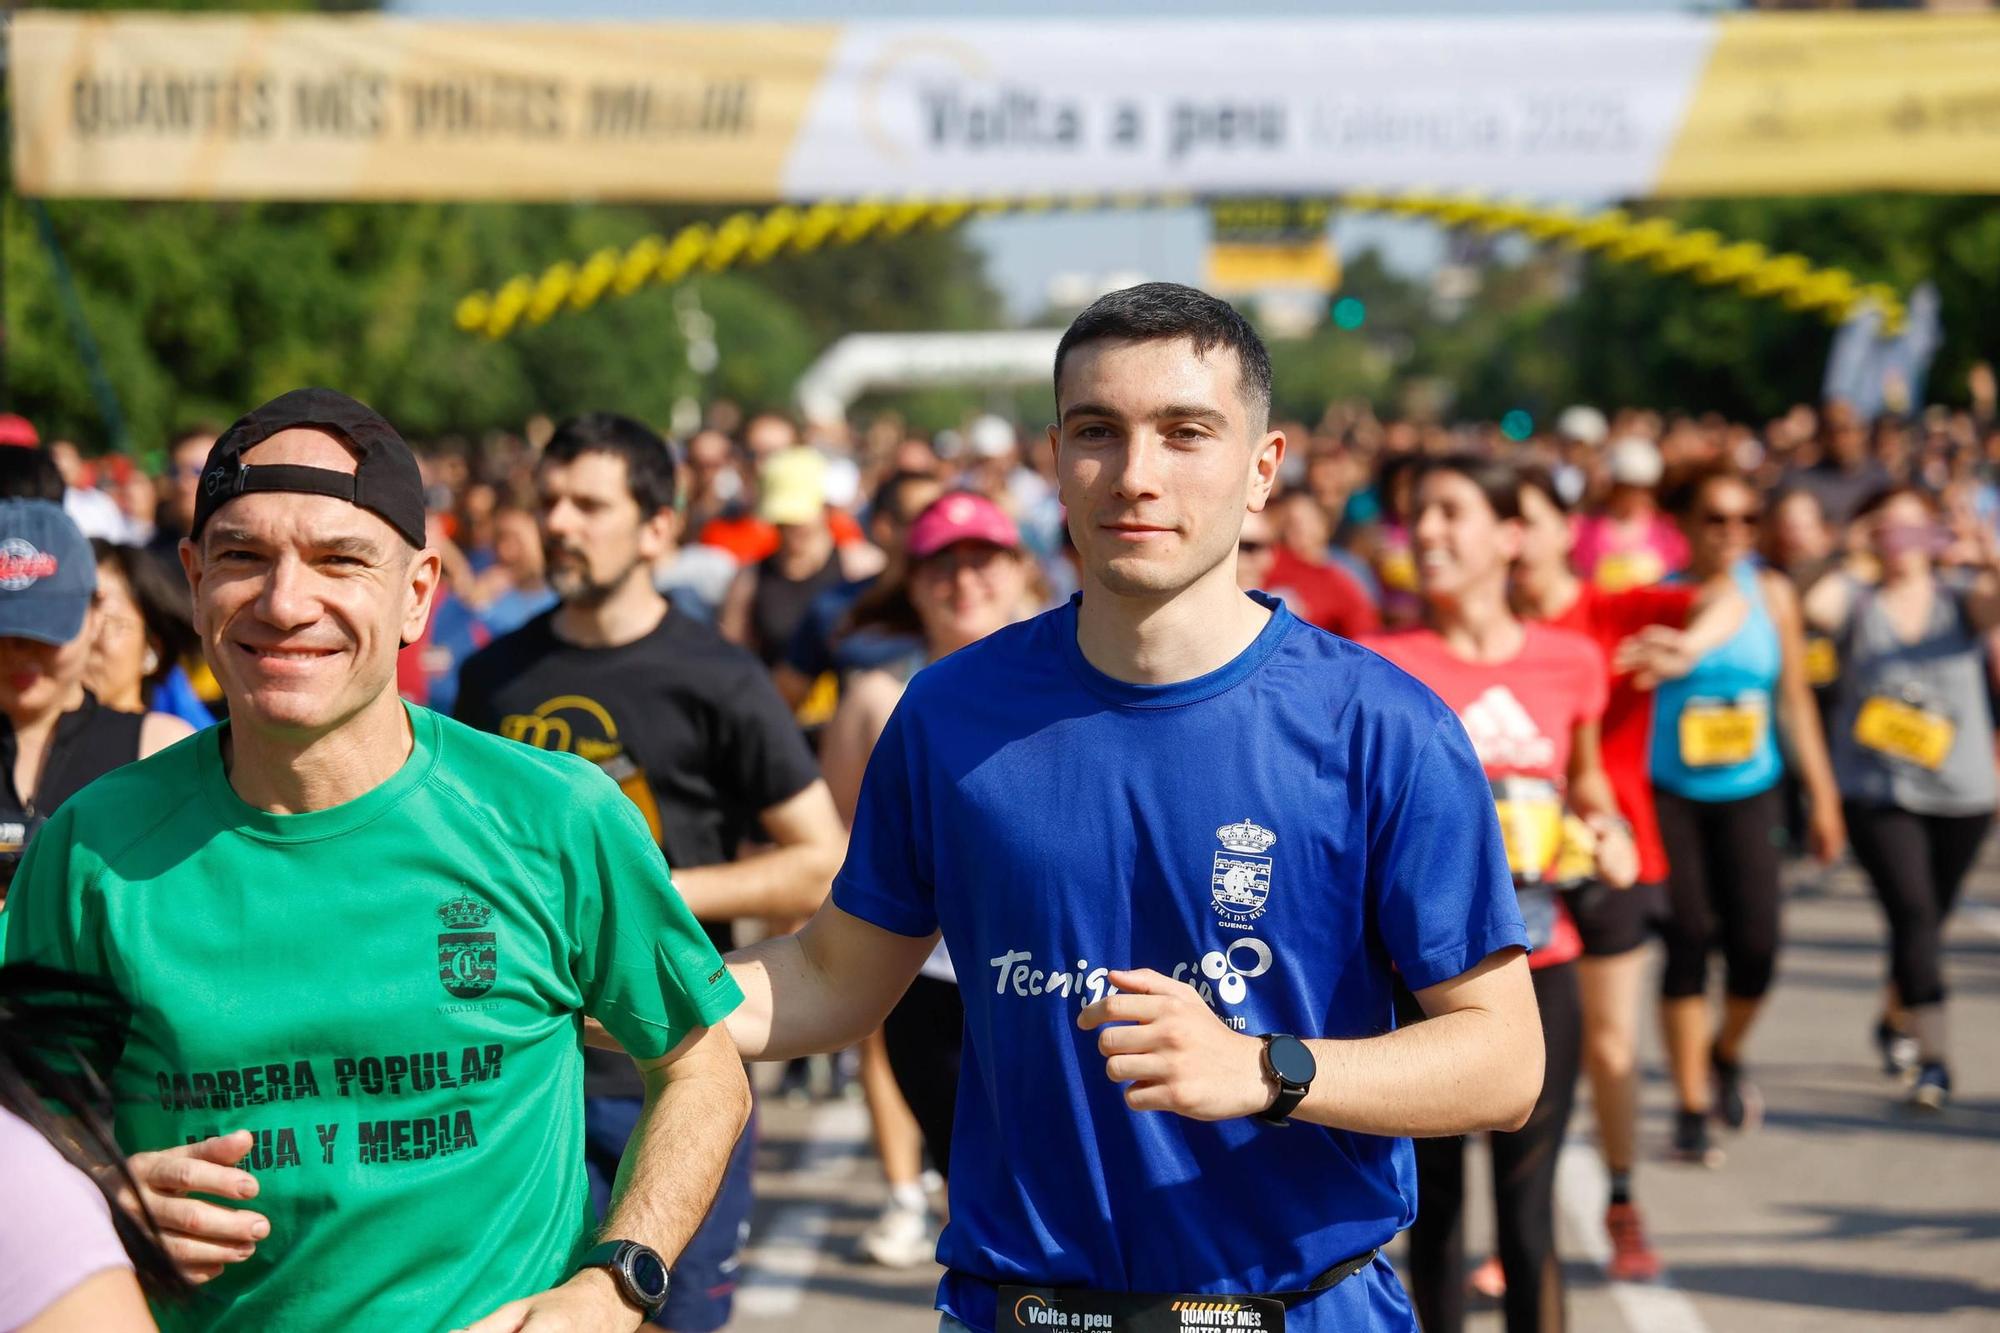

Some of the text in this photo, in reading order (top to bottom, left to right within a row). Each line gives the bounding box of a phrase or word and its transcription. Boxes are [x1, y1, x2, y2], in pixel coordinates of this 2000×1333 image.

[917, 83, 1081, 148] Volta
[1110, 98, 1141, 148] a
[1168, 97, 1284, 164] peu
[1211, 900, 1267, 922] VARA DE REY
[1218, 921, 1254, 931] CUENCA
[435, 1001, 501, 1016] VARA DE REY
[156, 1044, 504, 1112] CARRERA POPULAR
[316, 1123, 339, 1165] Y
[358, 1109, 478, 1165] MEDIA
[1028, 1306, 1113, 1331] Volta a peu
[1180, 1307, 1262, 1327] QUANTES MÉS
